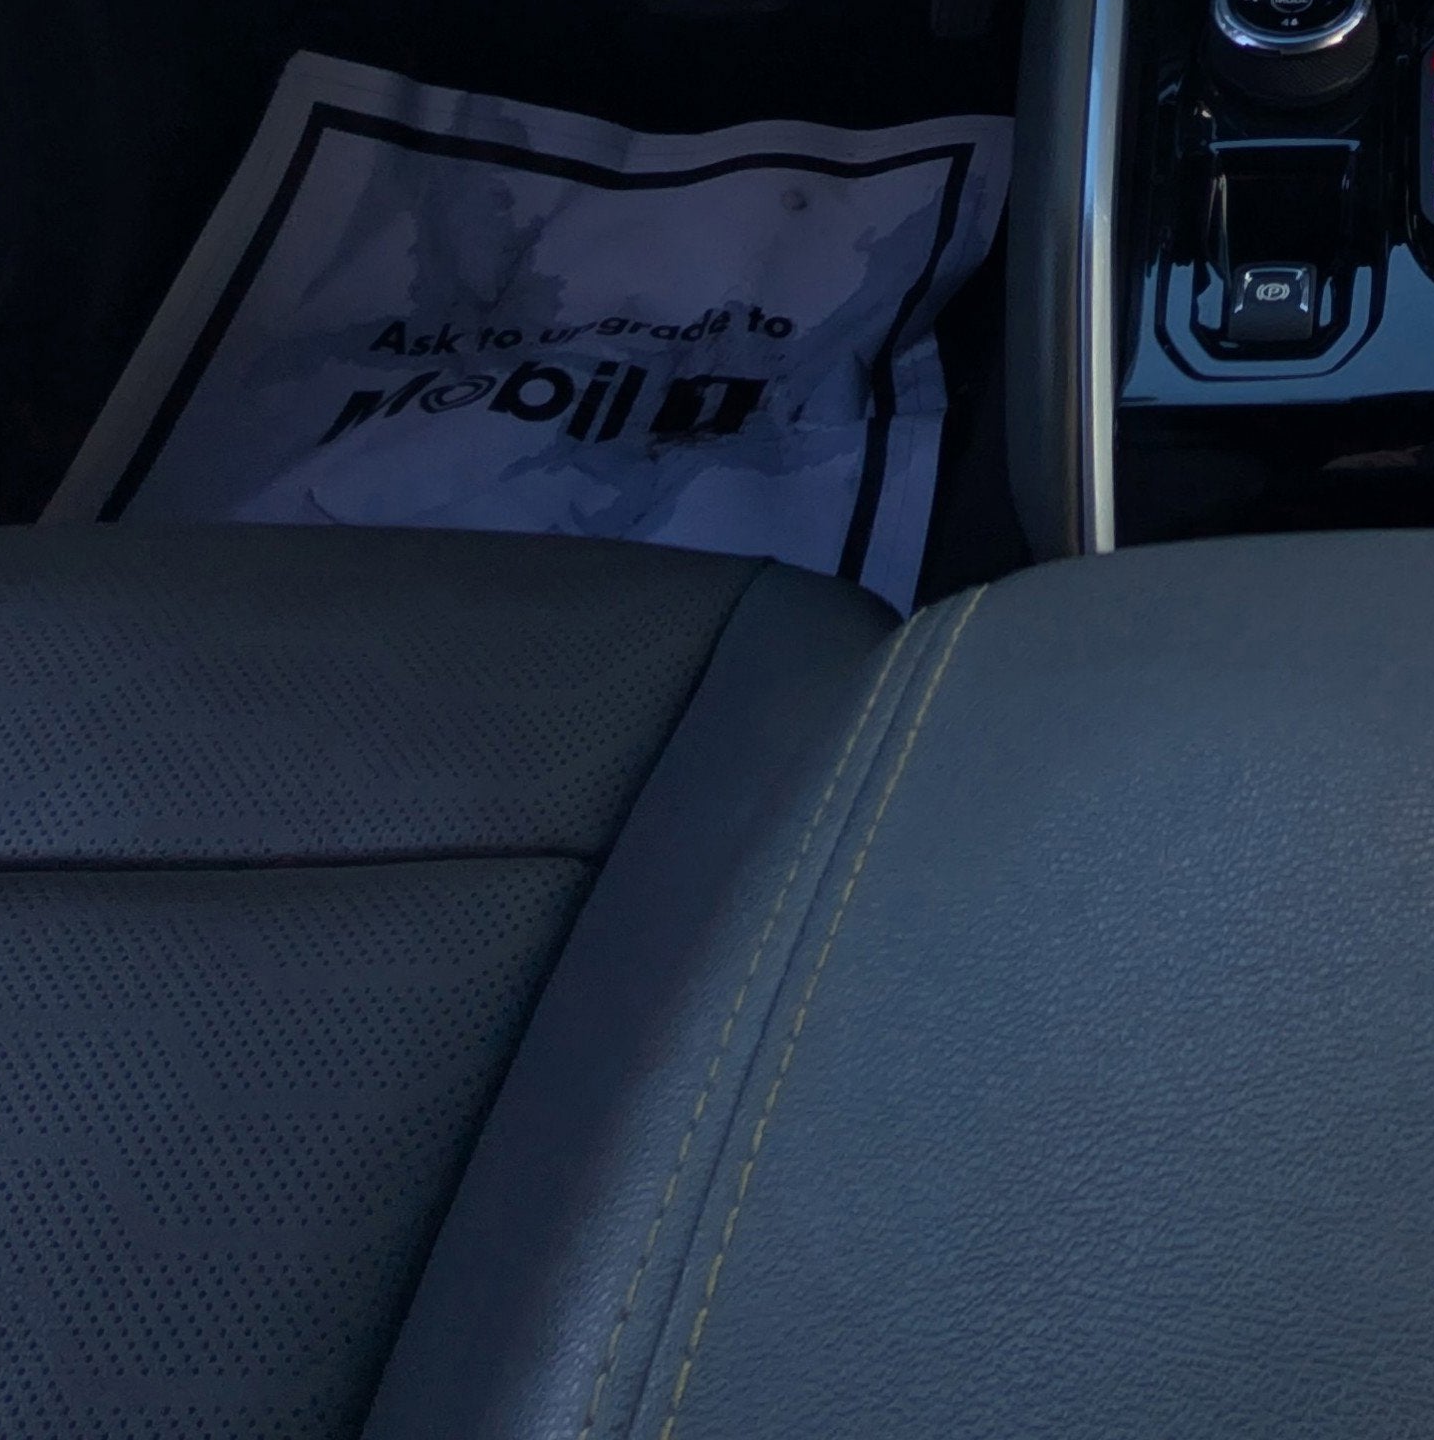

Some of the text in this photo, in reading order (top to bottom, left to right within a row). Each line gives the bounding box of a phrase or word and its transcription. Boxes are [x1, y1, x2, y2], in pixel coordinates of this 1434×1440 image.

[370, 321, 463, 356] Ask
[477, 326, 522, 352] to
[748, 306, 792, 339] to
[316, 360, 647, 445] Mobil
